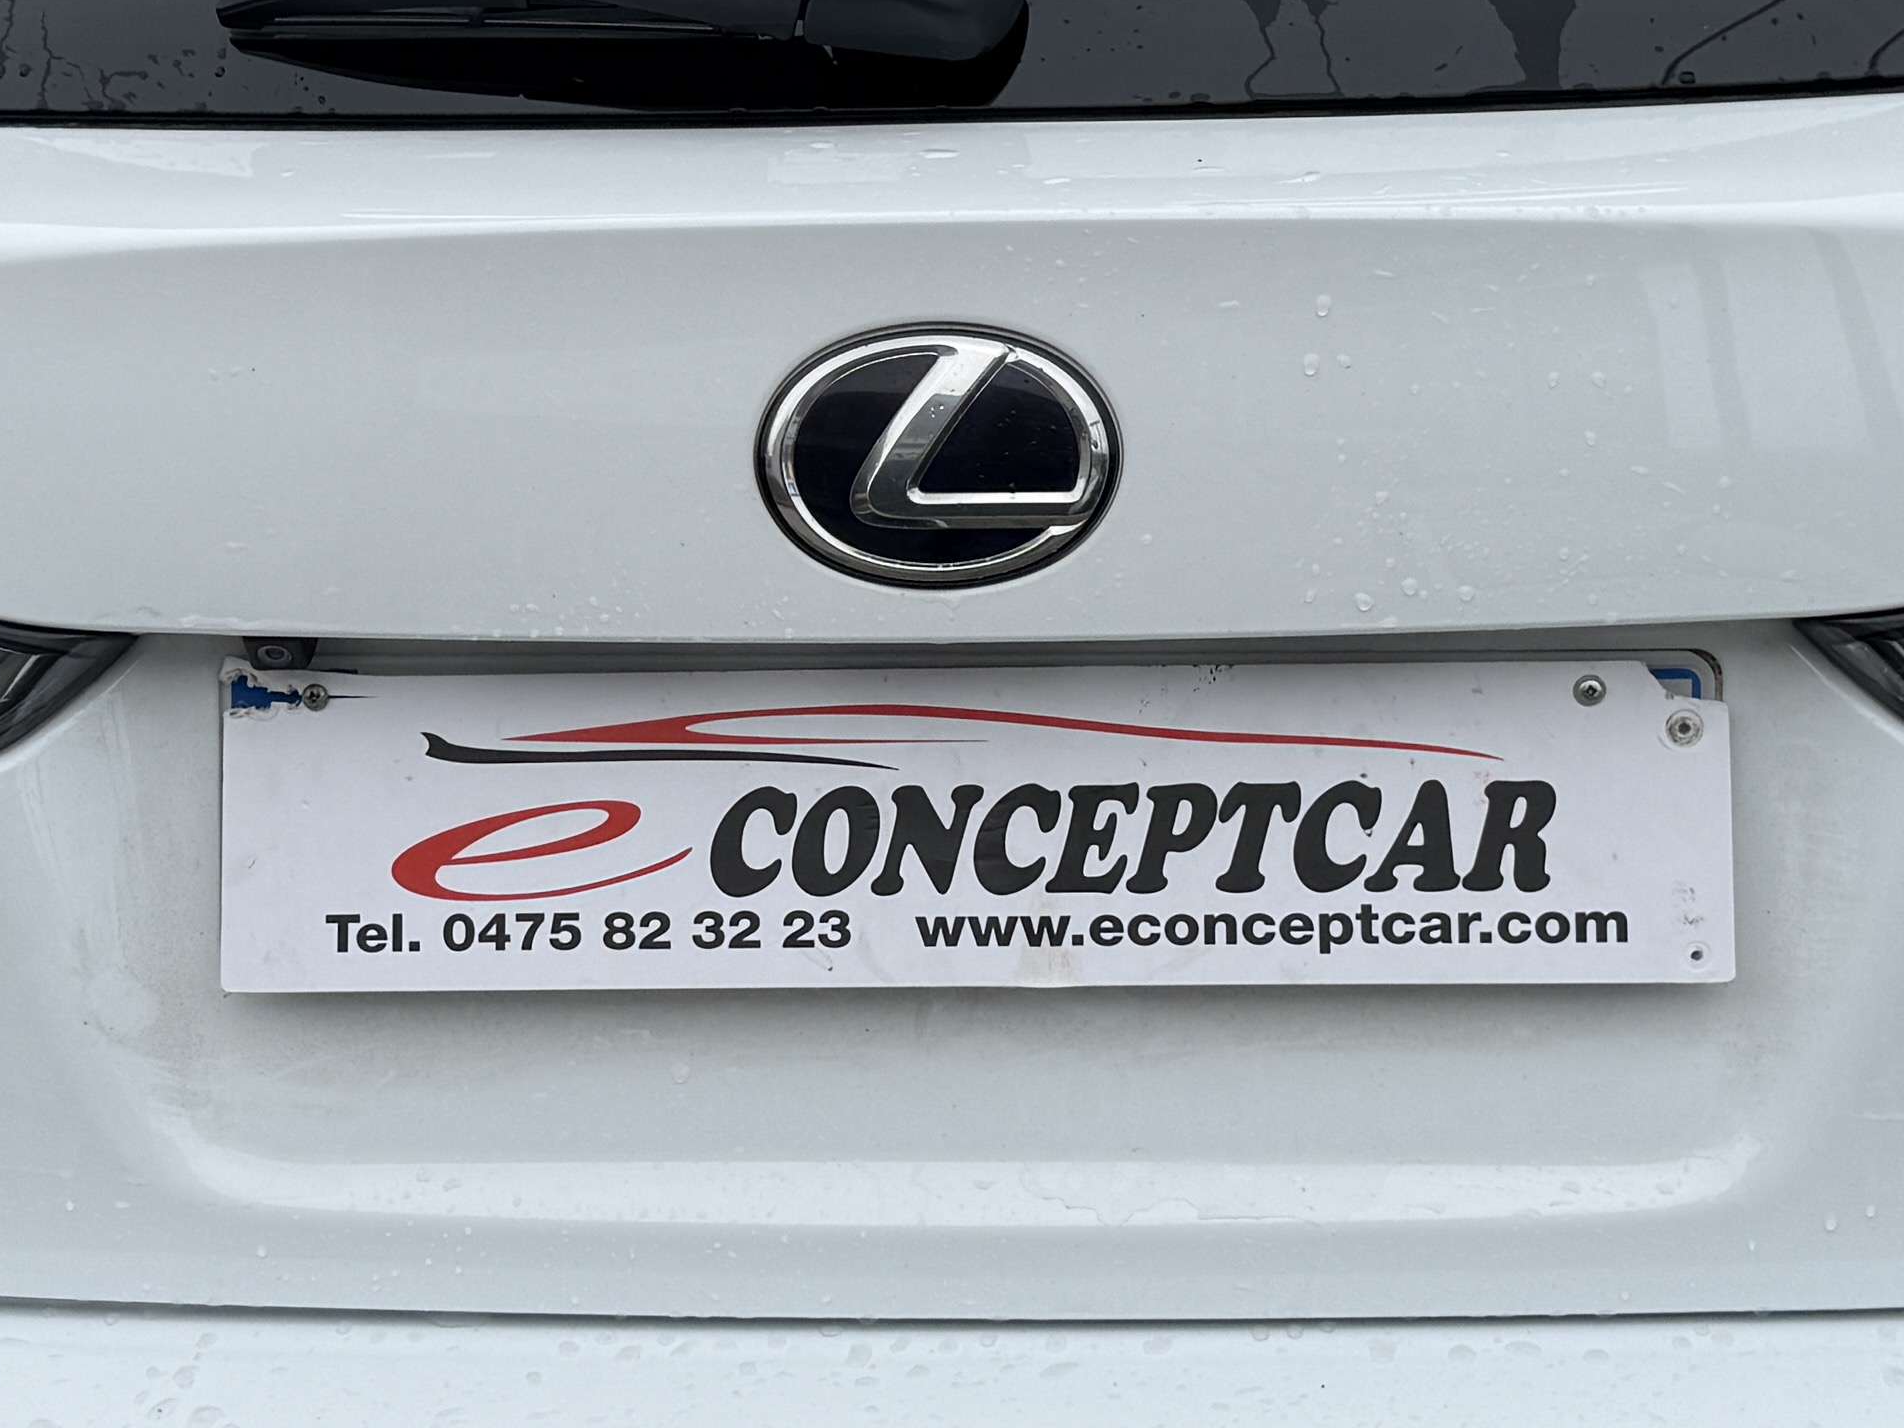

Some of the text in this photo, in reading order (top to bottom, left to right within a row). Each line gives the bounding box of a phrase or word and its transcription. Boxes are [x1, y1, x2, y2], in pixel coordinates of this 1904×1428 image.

[709, 779, 1557, 898] CONCEPTCAR
[325, 904, 1628, 955] Tel. 0475 82 32 23 www.econceptcar.com
